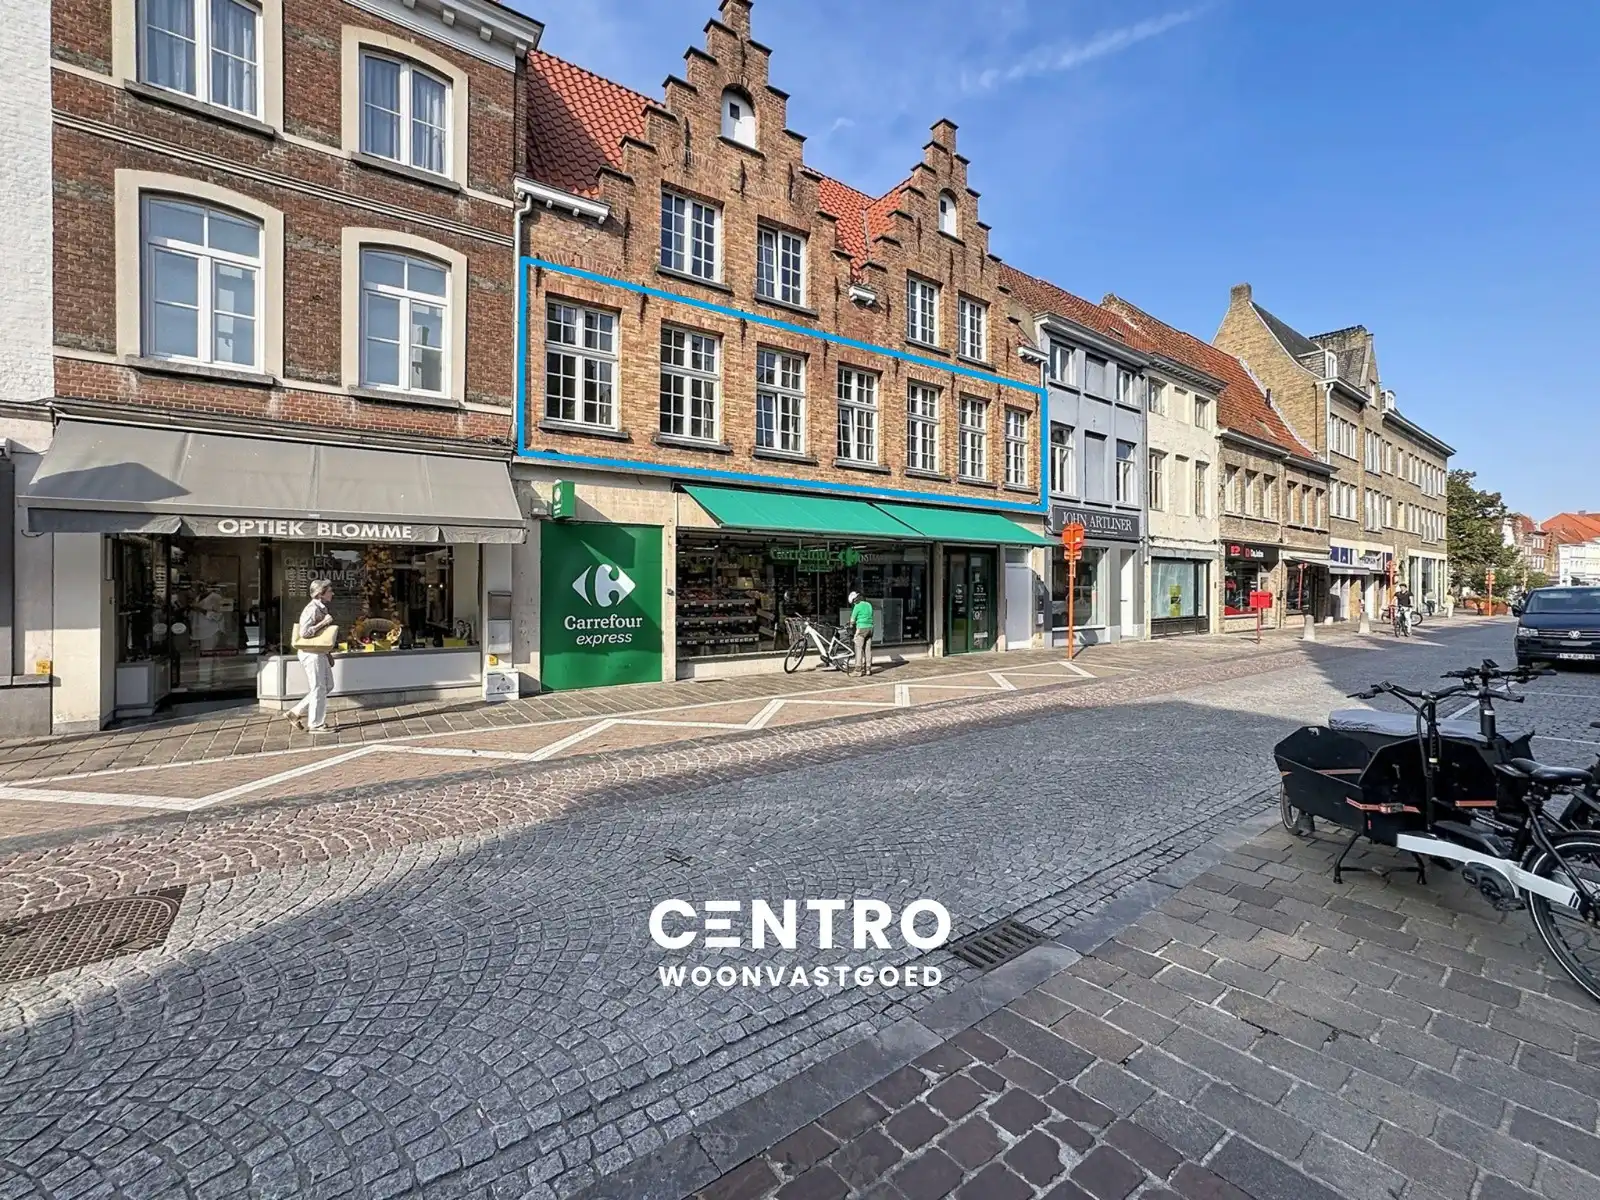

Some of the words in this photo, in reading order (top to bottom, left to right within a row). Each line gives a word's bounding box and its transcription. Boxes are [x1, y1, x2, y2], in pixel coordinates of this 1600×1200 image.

[217, 518, 305, 536] OPTIEK
[317, 522, 412, 539] BLOMME
[1061, 511, 1087, 527] JOHN
[1089, 515, 1133, 532] ARTLINER
[564, 613, 643, 630] Carrefour
[576, 632, 633, 648] express
